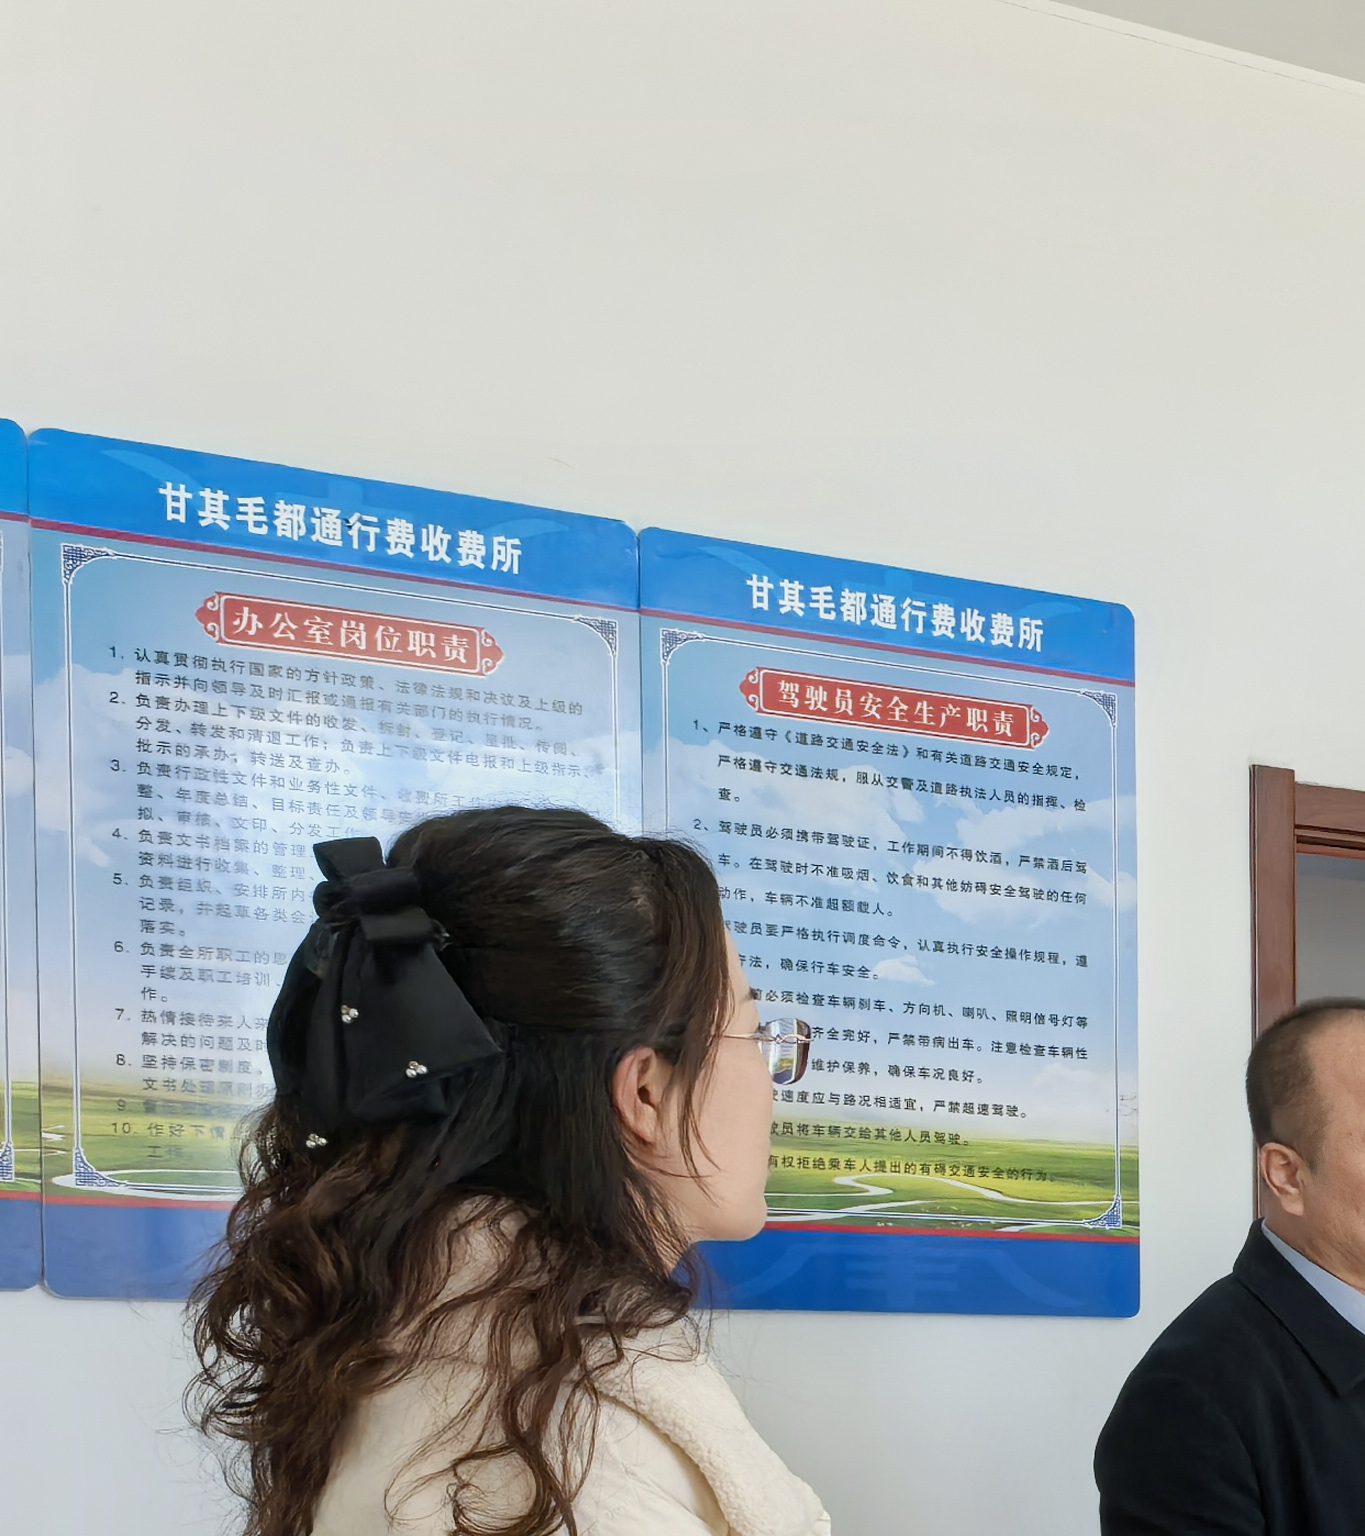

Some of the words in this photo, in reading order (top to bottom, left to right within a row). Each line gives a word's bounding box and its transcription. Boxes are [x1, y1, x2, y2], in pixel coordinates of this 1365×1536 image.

[158, 481, 523, 576] 甘其毛都通行费收费所
[231, 606, 471, 664] 办公室岗位职责
[746, 573, 1044, 653] 甘其毛都通行费收费所
[777, 678, 1015, 738] 驾驶员安全生产职责
